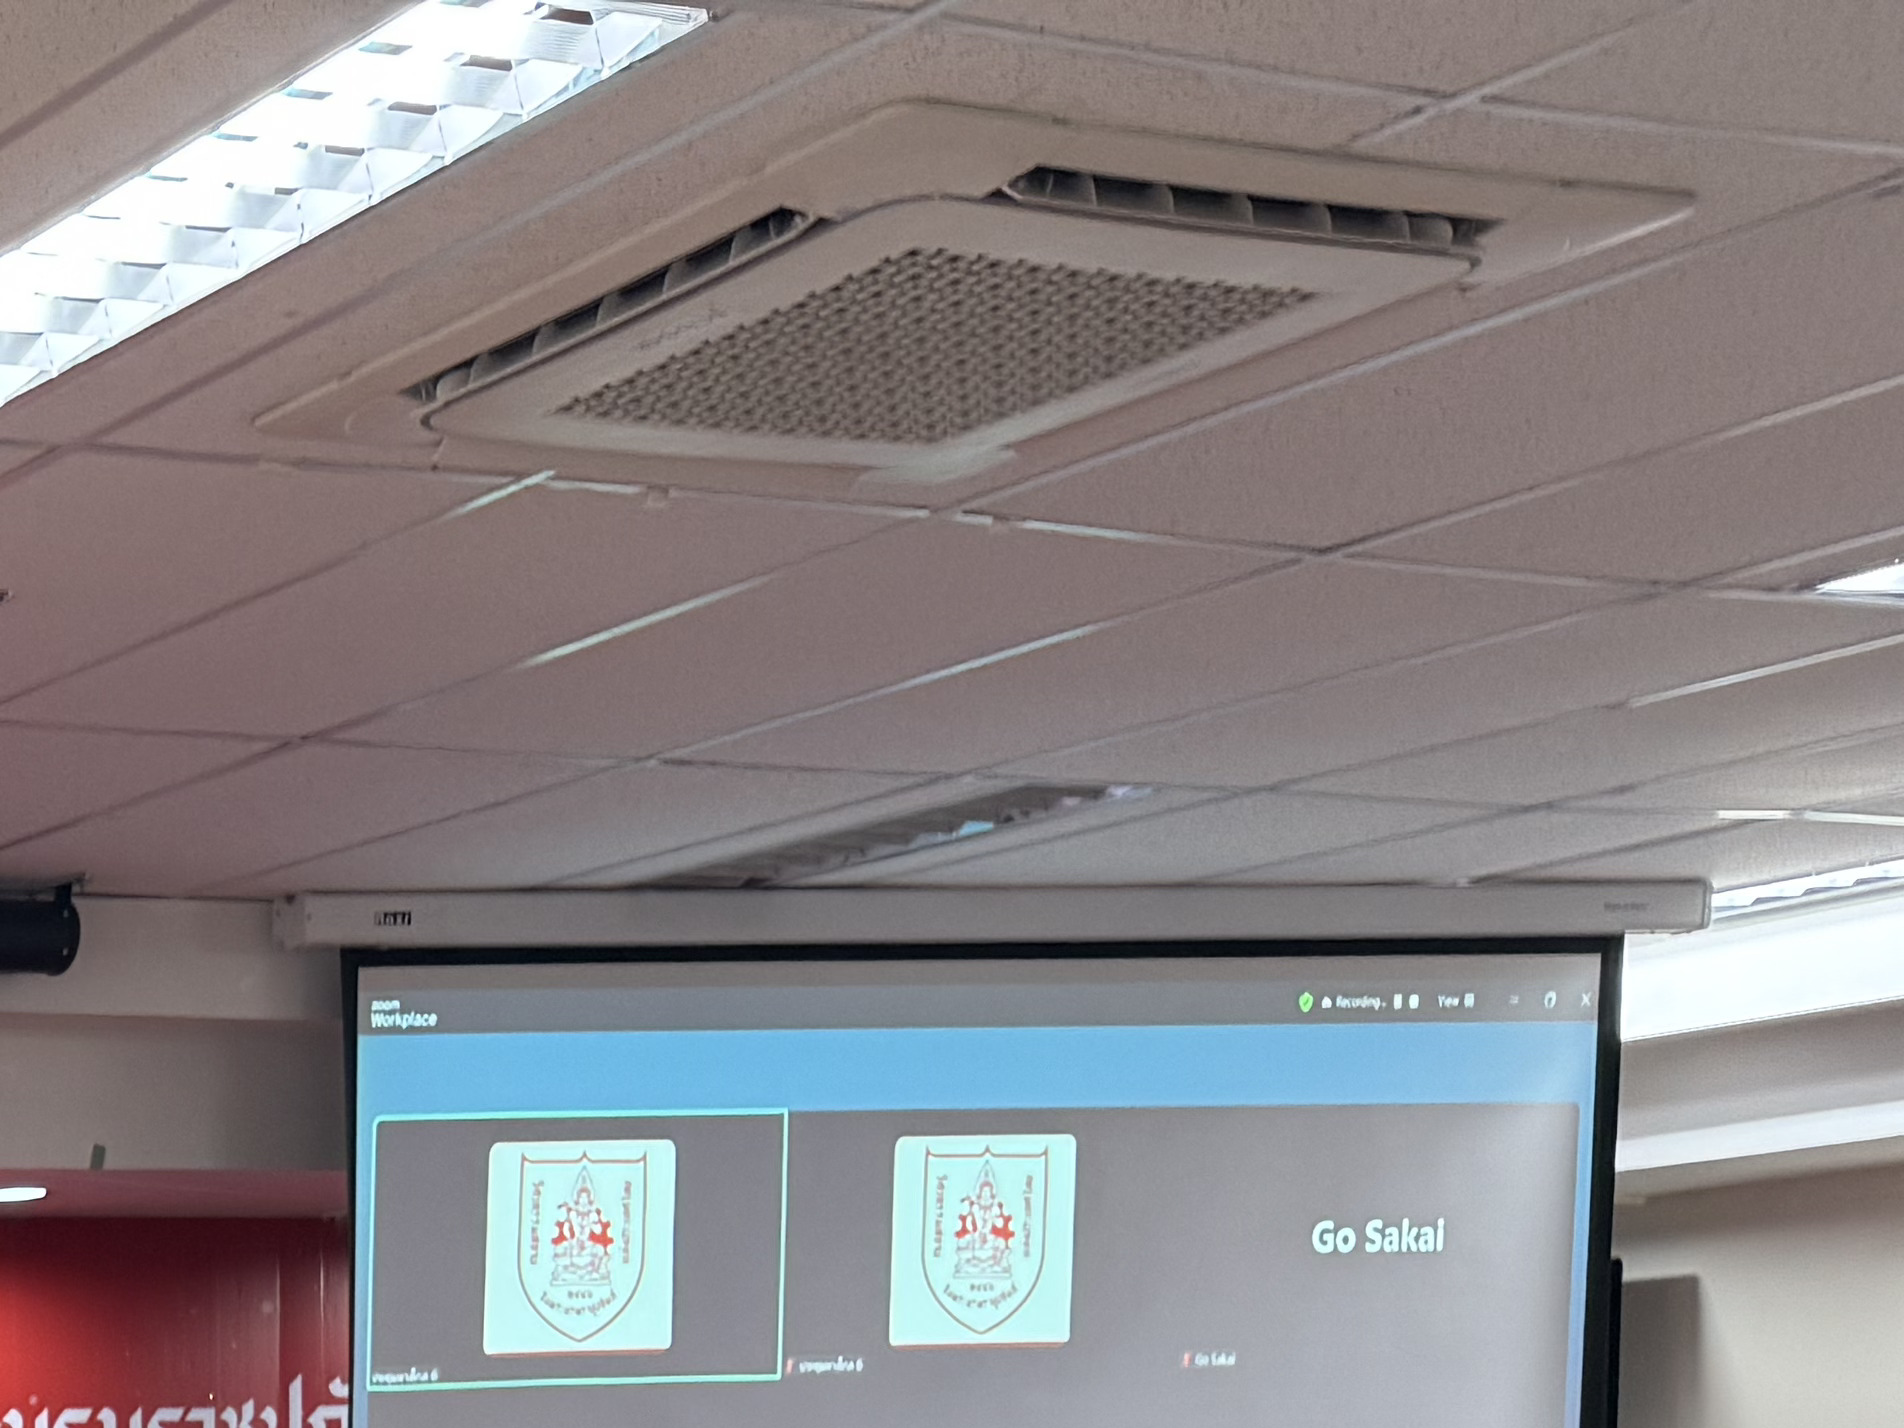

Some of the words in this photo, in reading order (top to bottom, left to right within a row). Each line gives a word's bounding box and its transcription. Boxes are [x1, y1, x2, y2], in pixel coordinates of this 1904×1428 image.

[370, 1011, 438, 1029] Workplace
[1312, 1220, 1356, 1254] Go
[1365, 1218, 1444, 1254] Sakai
